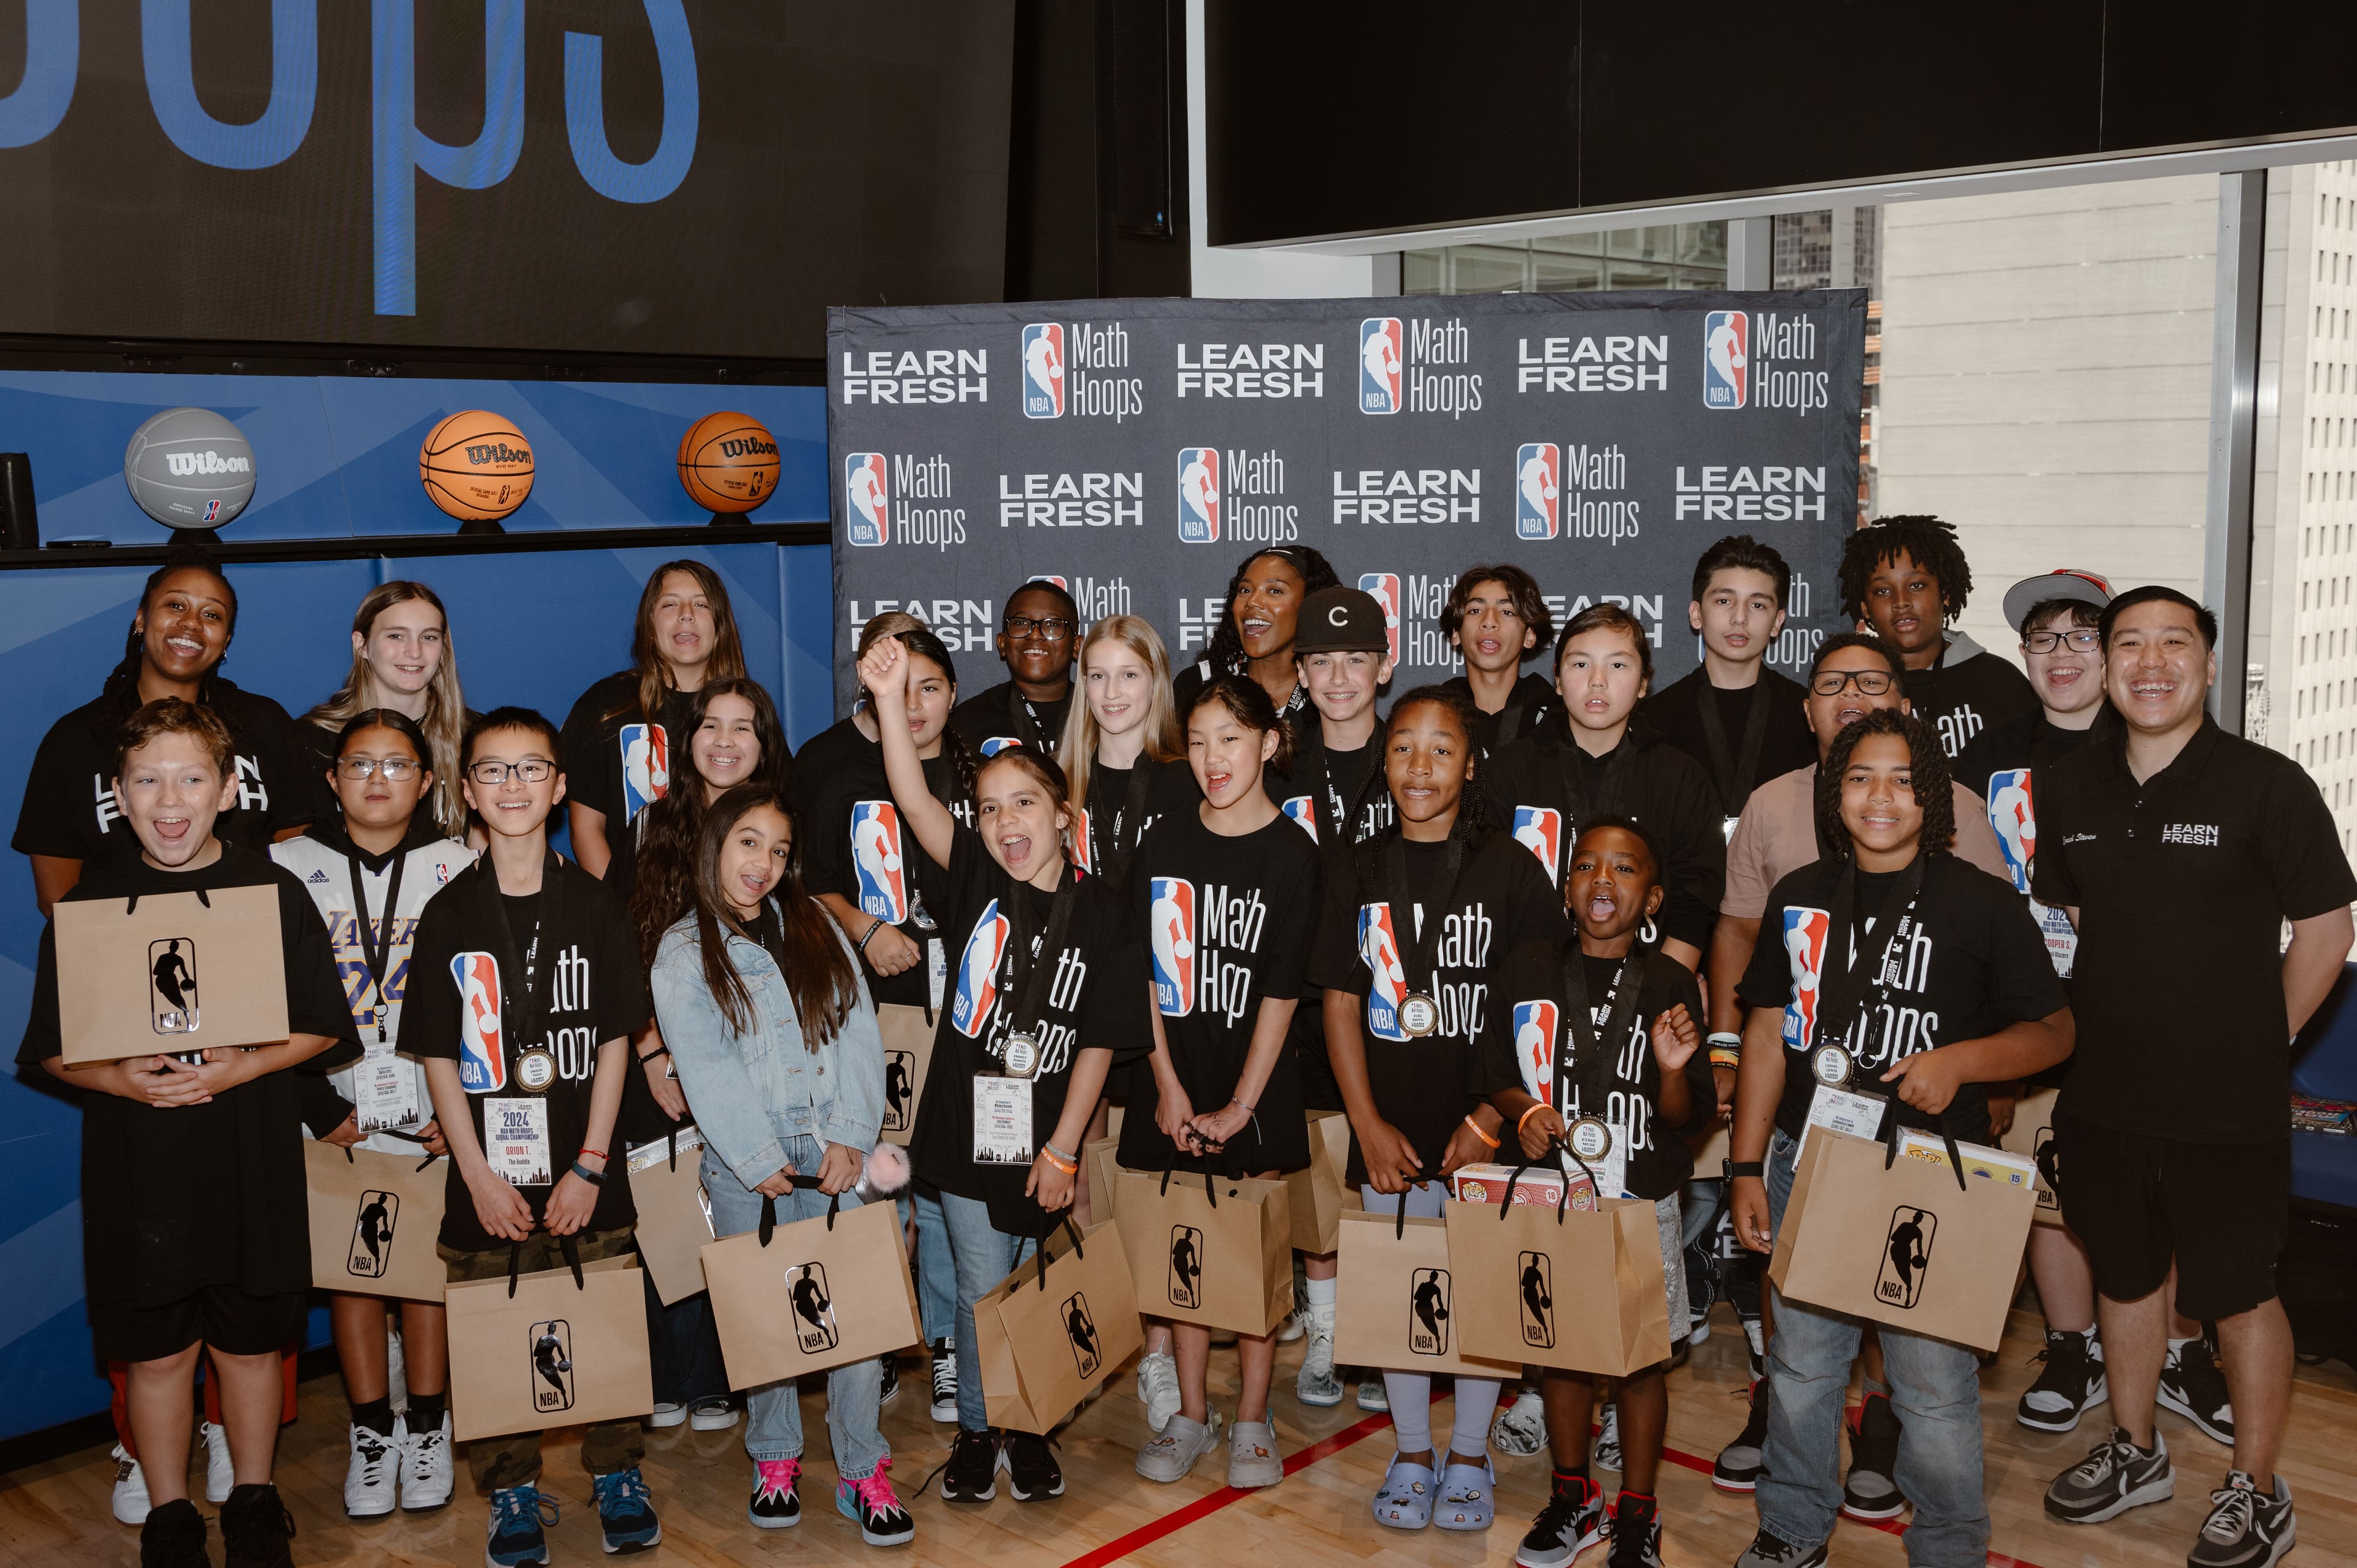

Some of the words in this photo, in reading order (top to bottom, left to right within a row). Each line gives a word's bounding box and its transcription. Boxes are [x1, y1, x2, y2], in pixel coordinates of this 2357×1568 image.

[1073, 322, 1128, 368] Math
[1411, 319, 1468, 364] Math
[1757, 313, 1815, 360] Math
[1178, 344, 1323, 370] LEARN
[1519, 336, 1668, 364] LEARN
[844, 349, 986, 377] LEARN
[1178, 372, 1323, 398] FRESH
[1518, 365, 1668, 392] FRESH
[1756, 362, 1828, 416] Hoops
[844, 377, 987, 404] FRESH
[1073, 374, 1142, 423] Hoops
[1366, 393, 1385, 408] NBA
[1411, 367, 1482, 420] Hoops
[1711, 388, 1730, 402] NBA
[1030, 397, 1049, 412] NBA
[465, 443, 531, 465] Wilson
[719, 437, 778, 458] Wilson
[166, 451, 249, 476] Wilson
[1229, 450, 1283, 494] Math
[1569, 445, 1625, 490] Math
[896, 454, 950, 498] Math
[1001, 473, 1143, 499] LEARN
[1334, 469, 1481, 496] LEARN
[1676, 467, 1826, 493] LEARN
[1001, 500, 1143, 527] FRESH
[1333, 497, 1480, 524] FRESH
[1676, 495, 1825, 521] FRESH
[896, 501, 966, 552] Hoops
[1185, 521, 1204, 537] NBA
[1229, 497, 1298, 546] Hoops
[1523, 519, 1543, 533] NBA
[1568, 493, 1639, 546] Hoops
[854, 525, 873, 540] NBA
[1075, 577, 1130, 620] Math
[1409, 575, 1457, 619] Mat
[1788, 573, 1810, 617] th
[1328, 606, 1348, 627] C
[1541, 595, 1663, 620] EARN
[851, 626, 992, 651] FSH
[1408, 622, 1465, 674] Hoop
[1766, 628, 1823, 672] oops
[1288, 685, 1300, 707] LEARN
[1937, 704, 1983, 758] ath
[1328, 784, 1336, 803] LEARN
[2075, 833, 2097, 841] Steven
[2161, 833, 2218, 846] FRESH
[2163, 824, 2219, 836] LEARN
[865, 894, 887, 916] NBA
[2047, 907, 2068, 921] 202
[328, 910, 420, 955] LAKER
[1897, 915, 1907, 936] FRESH
[1902, 916, 1911, 936] LEARN
[1033, 940, 1043, 958] LEARN
[2044, 938, 2065, 949] COOPER
[2066, 940, 2071, 949] S.
[1049, 948, 1086, 1012] th
[1612, 968, 1622, 986] LEARN
[1885, 959, 1894, 982] FRESH
[1889, 960, 1899, 983] LEARN
[160, 1012, 181, 1029] NBA
[1371, 1008, 1395, 1031] NBA
[1596, 1004, 1609, 1025] LEARN
[1600, 1006, 1612, 1026] FRESH
[503, 1112, 529, 1127] 2024
[506, 1146, 524, 1156] ORION
[526, 1146, 531, 1155] T.
[627, 1156, 648, 1176] POP!
[2011, 1174, 2021, 1183] 15
[1463, 1182, 1485, 1199] POP!
[1547, 1191, 1556, 1200] 18
[1572, 1187, 1590, 1206] POP!
[353, 1256, 371, 1271] NBA
[1173, 1288, 1189, 1303] NBA
[1881, 1280, 1902, 1300] NBA
[805, 1333, 824, 1348] NBA
[1415, 1335, 1432, 1349] NBA
[1527, 1325, 1543, 1342] NBA
[1082, 1357, 1093, 1374] NBA
[540, 1392, 560, 1407] NBA
